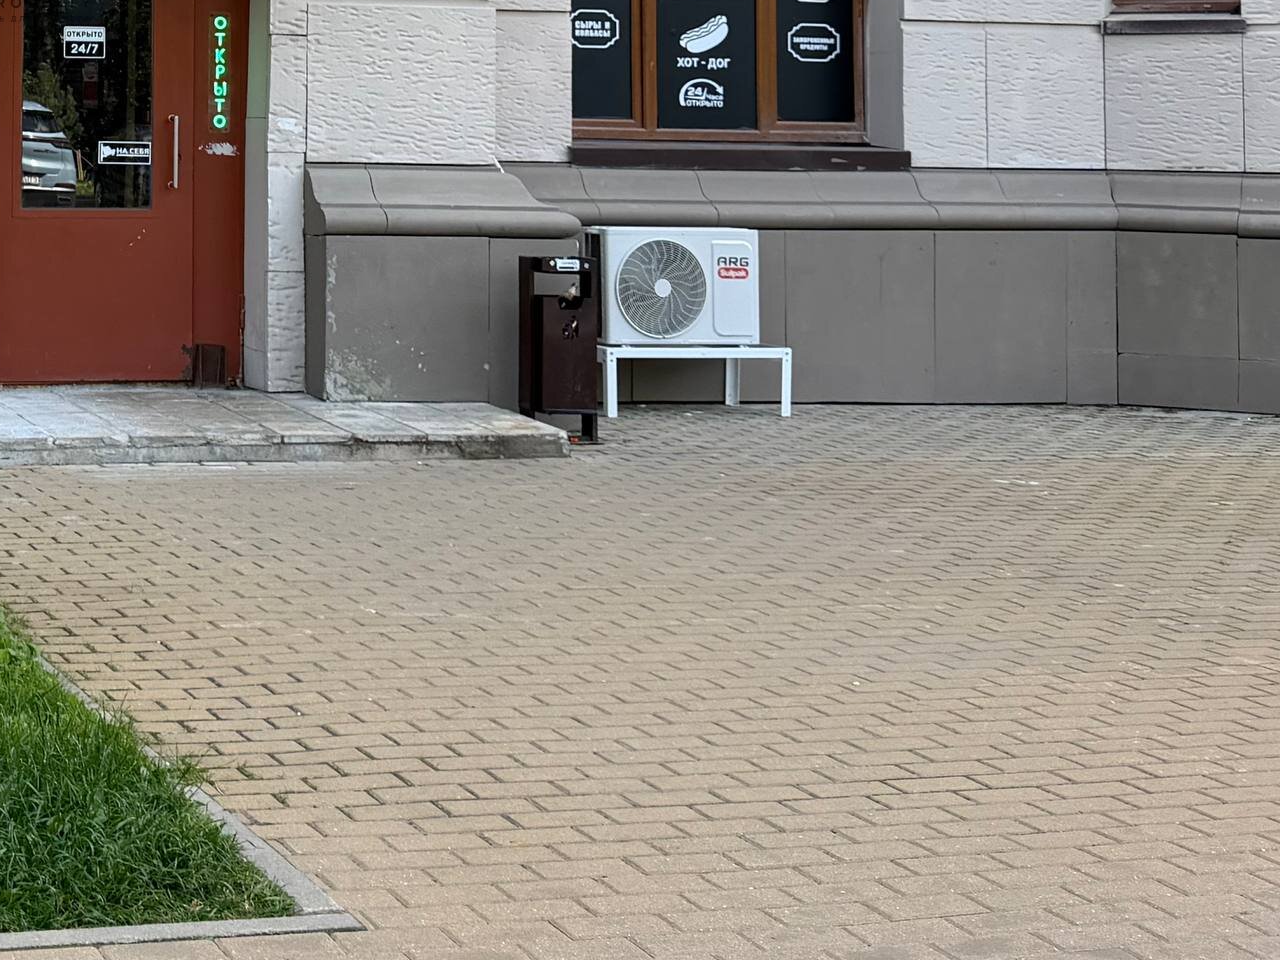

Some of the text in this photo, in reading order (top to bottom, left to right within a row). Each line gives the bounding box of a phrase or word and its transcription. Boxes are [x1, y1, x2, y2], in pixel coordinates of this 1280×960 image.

[574, 20, 610, 29] СЫРЫ И
[66, 30, 103, 38] ОТКРЫТО
[574, 28, 611, 38] КОЛБАСЫ
[70, 42, 99, 54] 24/7
[213, 15, 227, 129] ОТКРЫТО
[686, 99, 724, 108] ОТКРЫТО
[116, 147, 150, 155] НА СЕБЯ
[717, 256, 749, 267] ARG
